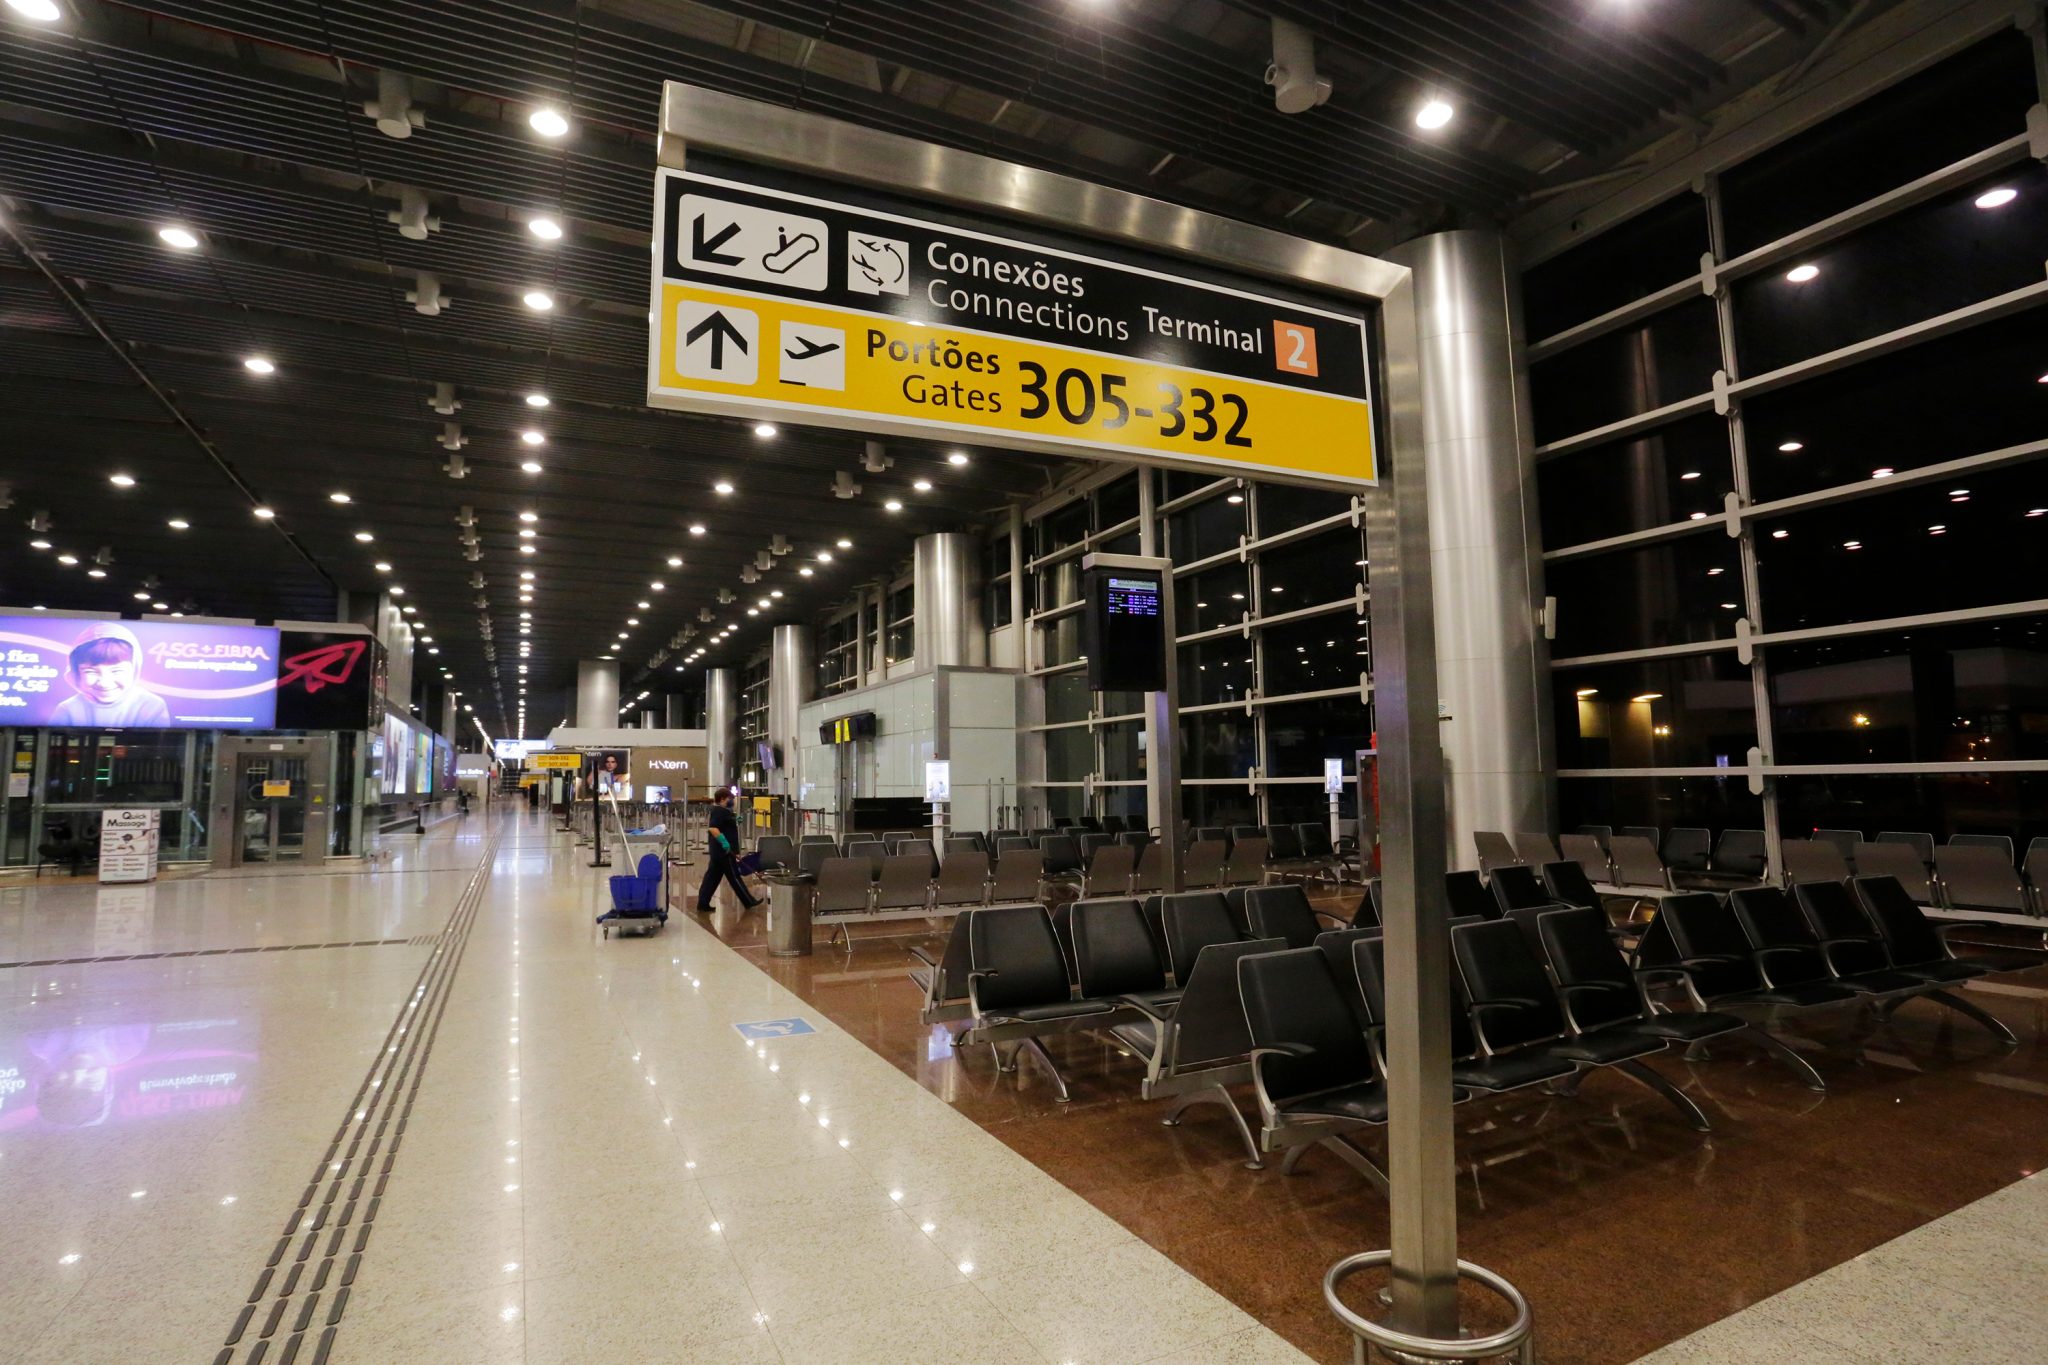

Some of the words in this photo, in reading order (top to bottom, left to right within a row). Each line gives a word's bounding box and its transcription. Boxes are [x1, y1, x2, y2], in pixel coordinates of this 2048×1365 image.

[927, 242, 1085, 299] Conexões
[927, 280, 1130, 341] Connections
[867, 329, 1001, 376] Portões
[1142, 306, 1264, 354] Terminal
[1287, 330, 1309, 369] 2
[902, 376, 1002, 413] Gates
[1018, 360, 1253, 448] 305-332
[215, 644, 271, 660] FIBRA
[107, 819, 147, 828] Massage
[122, 811, 147, 820] Quick
